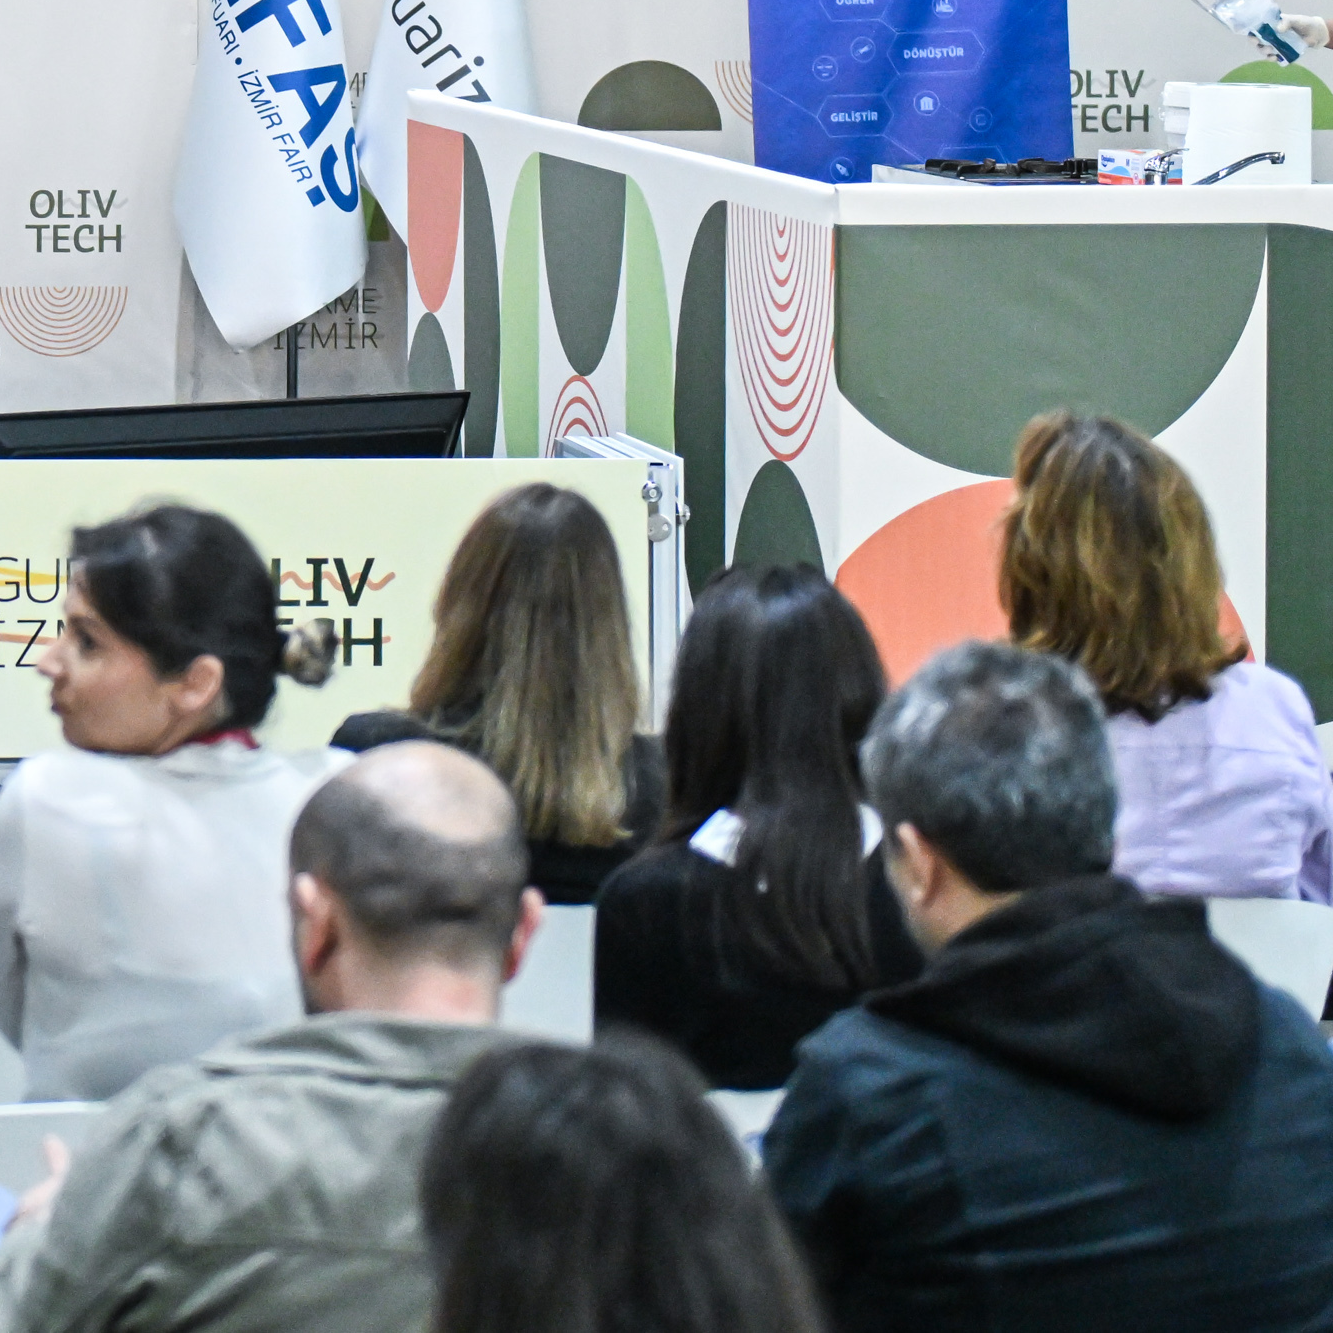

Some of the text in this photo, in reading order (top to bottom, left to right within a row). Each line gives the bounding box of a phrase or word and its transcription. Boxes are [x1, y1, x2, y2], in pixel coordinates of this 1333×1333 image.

[903, 45, 964, 59] DÖNÜŞTÜR
[237, 69, 283, 130] İZMİR
[272, 132, 313, 183] FAIR
[830, 109, 878, 123] GELİŞTİR
[29, 189, 117, 219] OLIV
[25, 224, 122, 253] TECH
